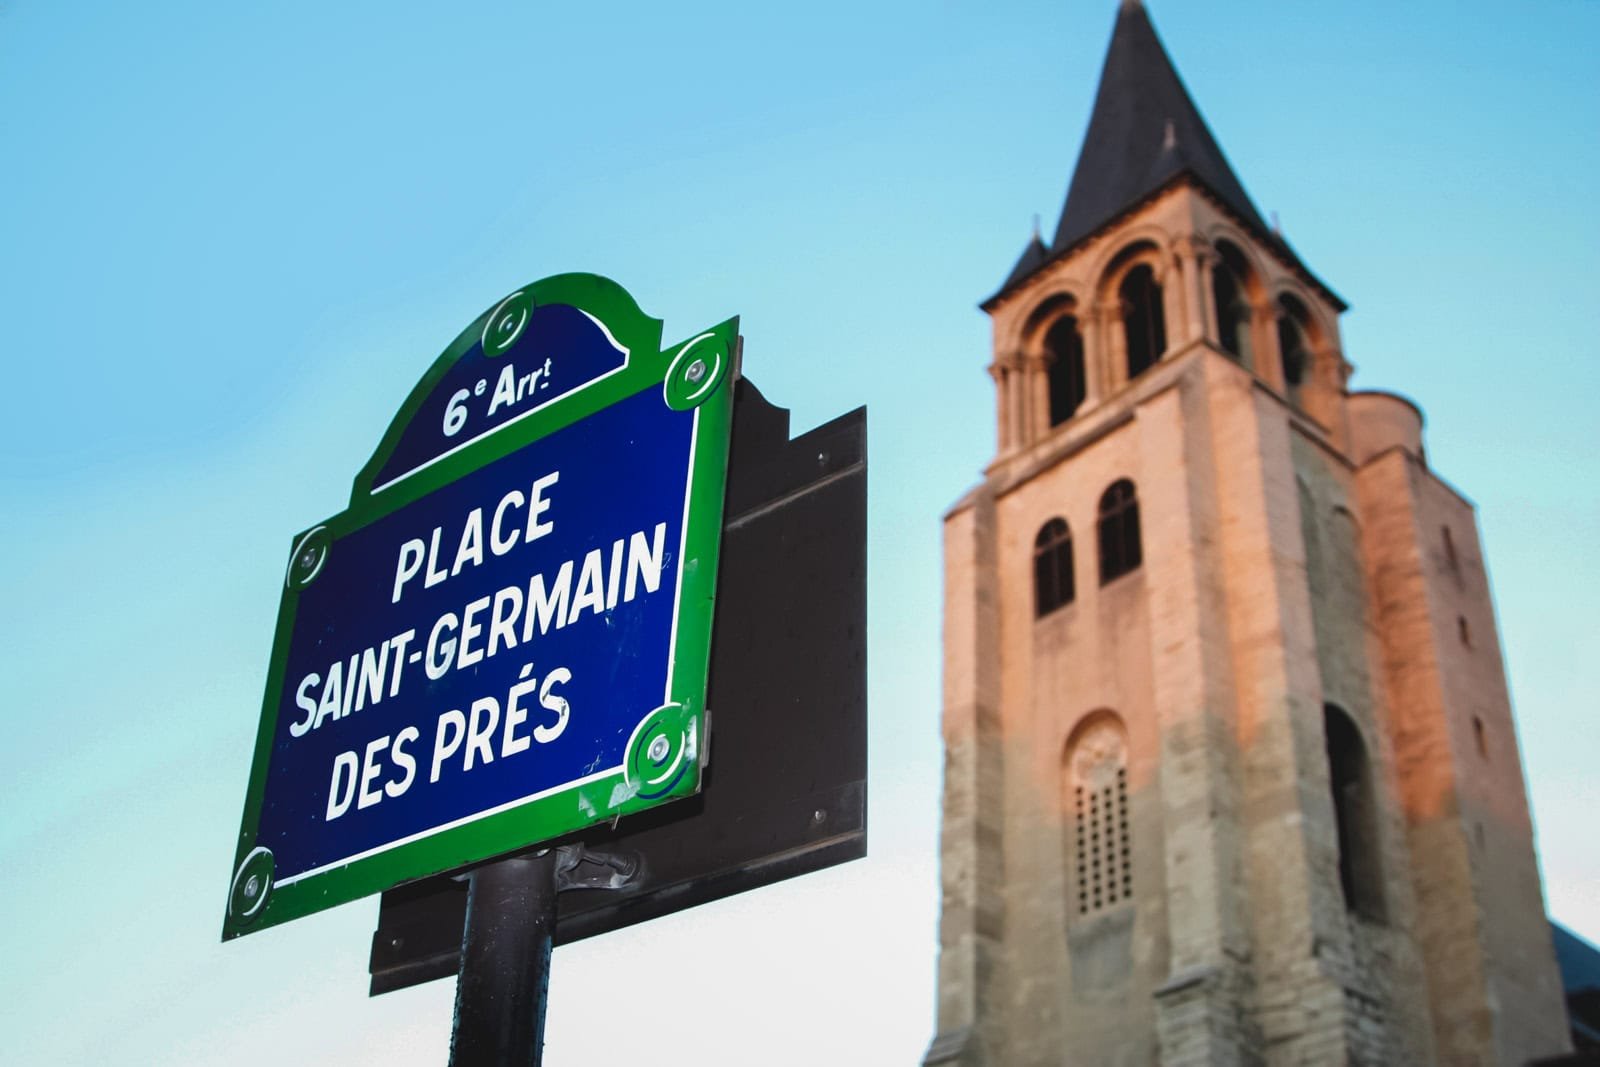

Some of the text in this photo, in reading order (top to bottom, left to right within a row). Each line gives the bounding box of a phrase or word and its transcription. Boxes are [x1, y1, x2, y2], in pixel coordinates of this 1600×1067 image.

[391, 470, 560, 604] PLACE
[289, 521, 668, 738] SAINT-GERMAIN
[325, 662, 572, 822] DES PRÉS
